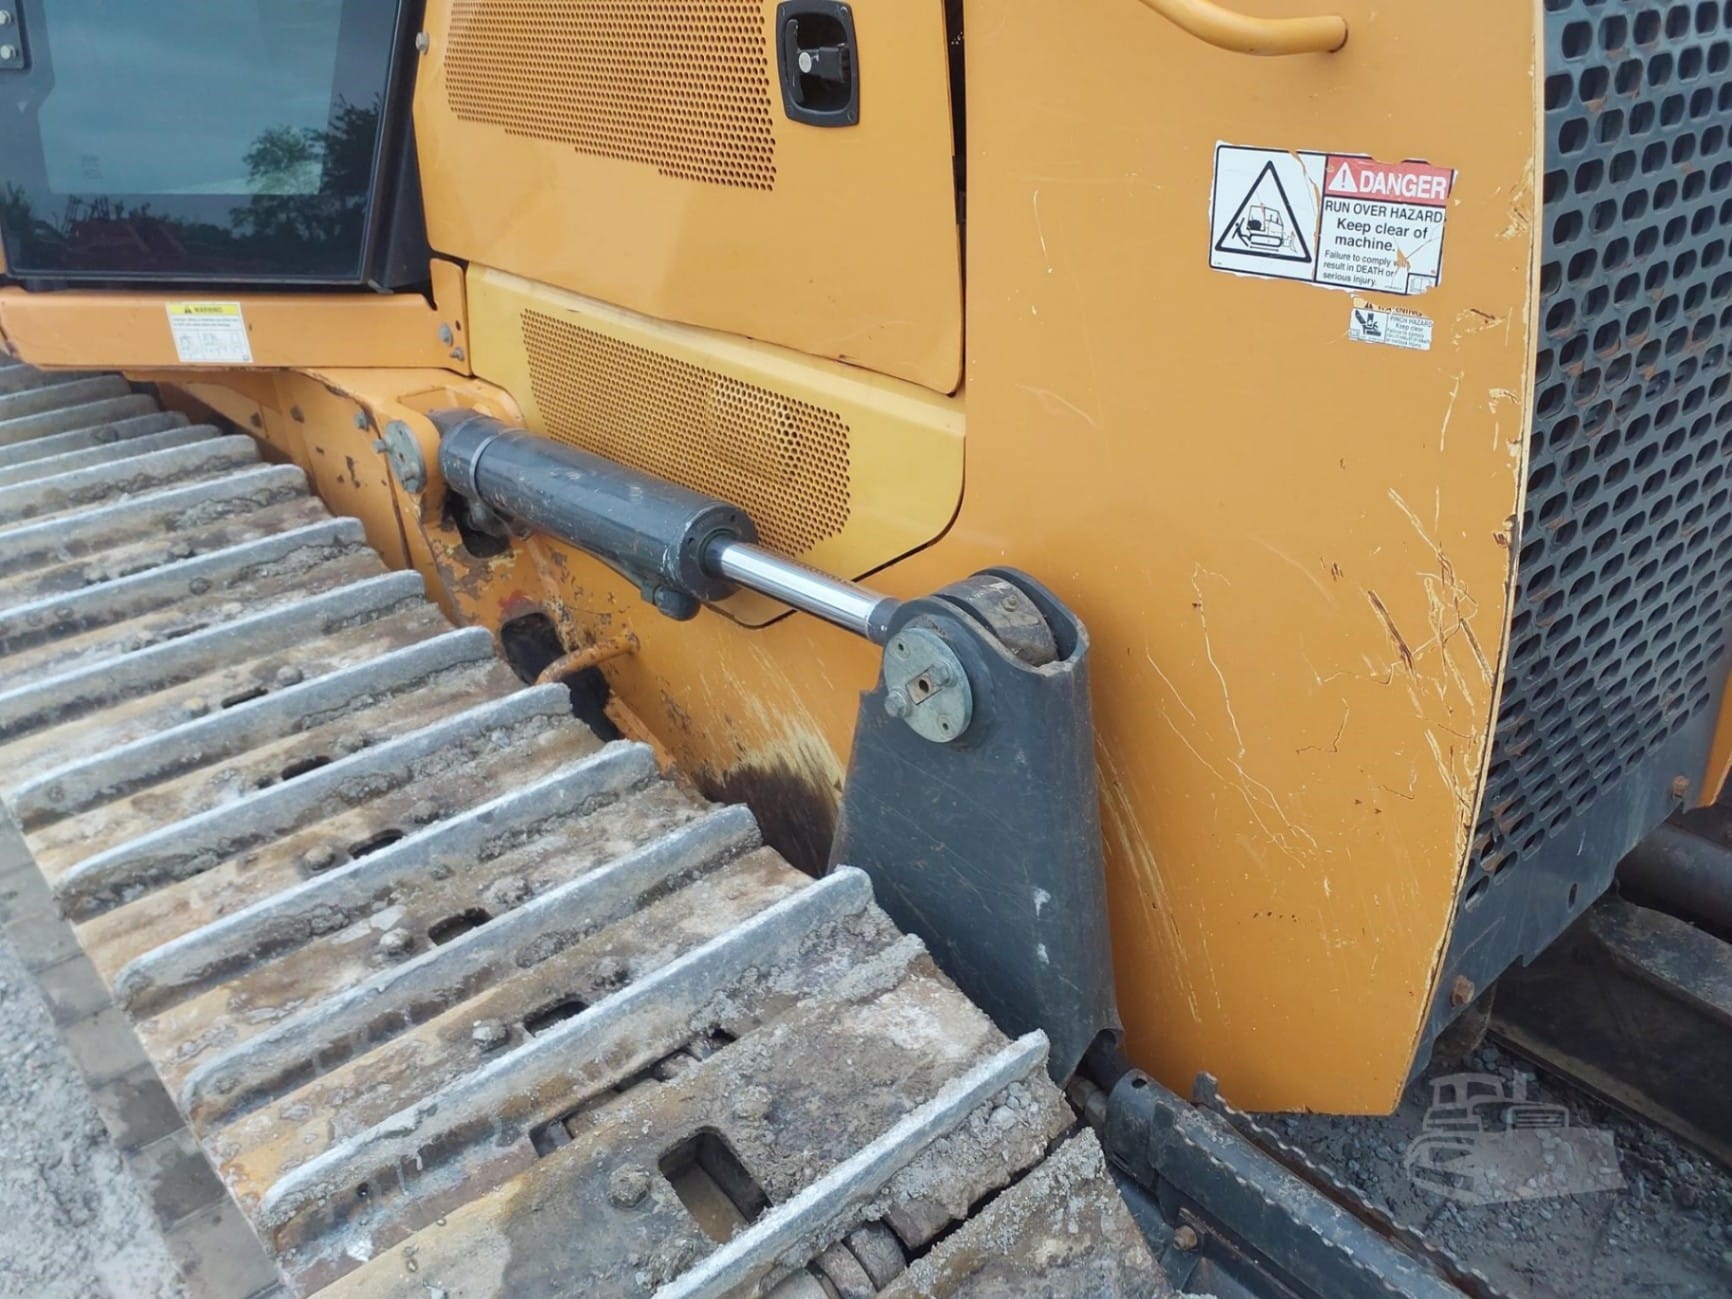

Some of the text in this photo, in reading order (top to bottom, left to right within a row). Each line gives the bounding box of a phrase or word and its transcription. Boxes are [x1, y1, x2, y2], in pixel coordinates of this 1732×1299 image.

[1359, 169, 1447, 200] DANGER
[1325, 199, 1443, 223] RUN OVER HAZARD
[1336, 217, 1429, 239] Keep clear of
[1334, 235, 1396, 252] machine.
[1324, 249, 1351, 261] Failure
[1352, 252, 1361, 261] to
[1361, 256, 1392, 268] comply
[1322, 271, 1352, 282] serious
[1323, 260, 1346, 271] result
[1346, 262, 1354, 272] in
[1355, 264, 1386, 276] DEATH
[1385, 269, 1395, 278] or
